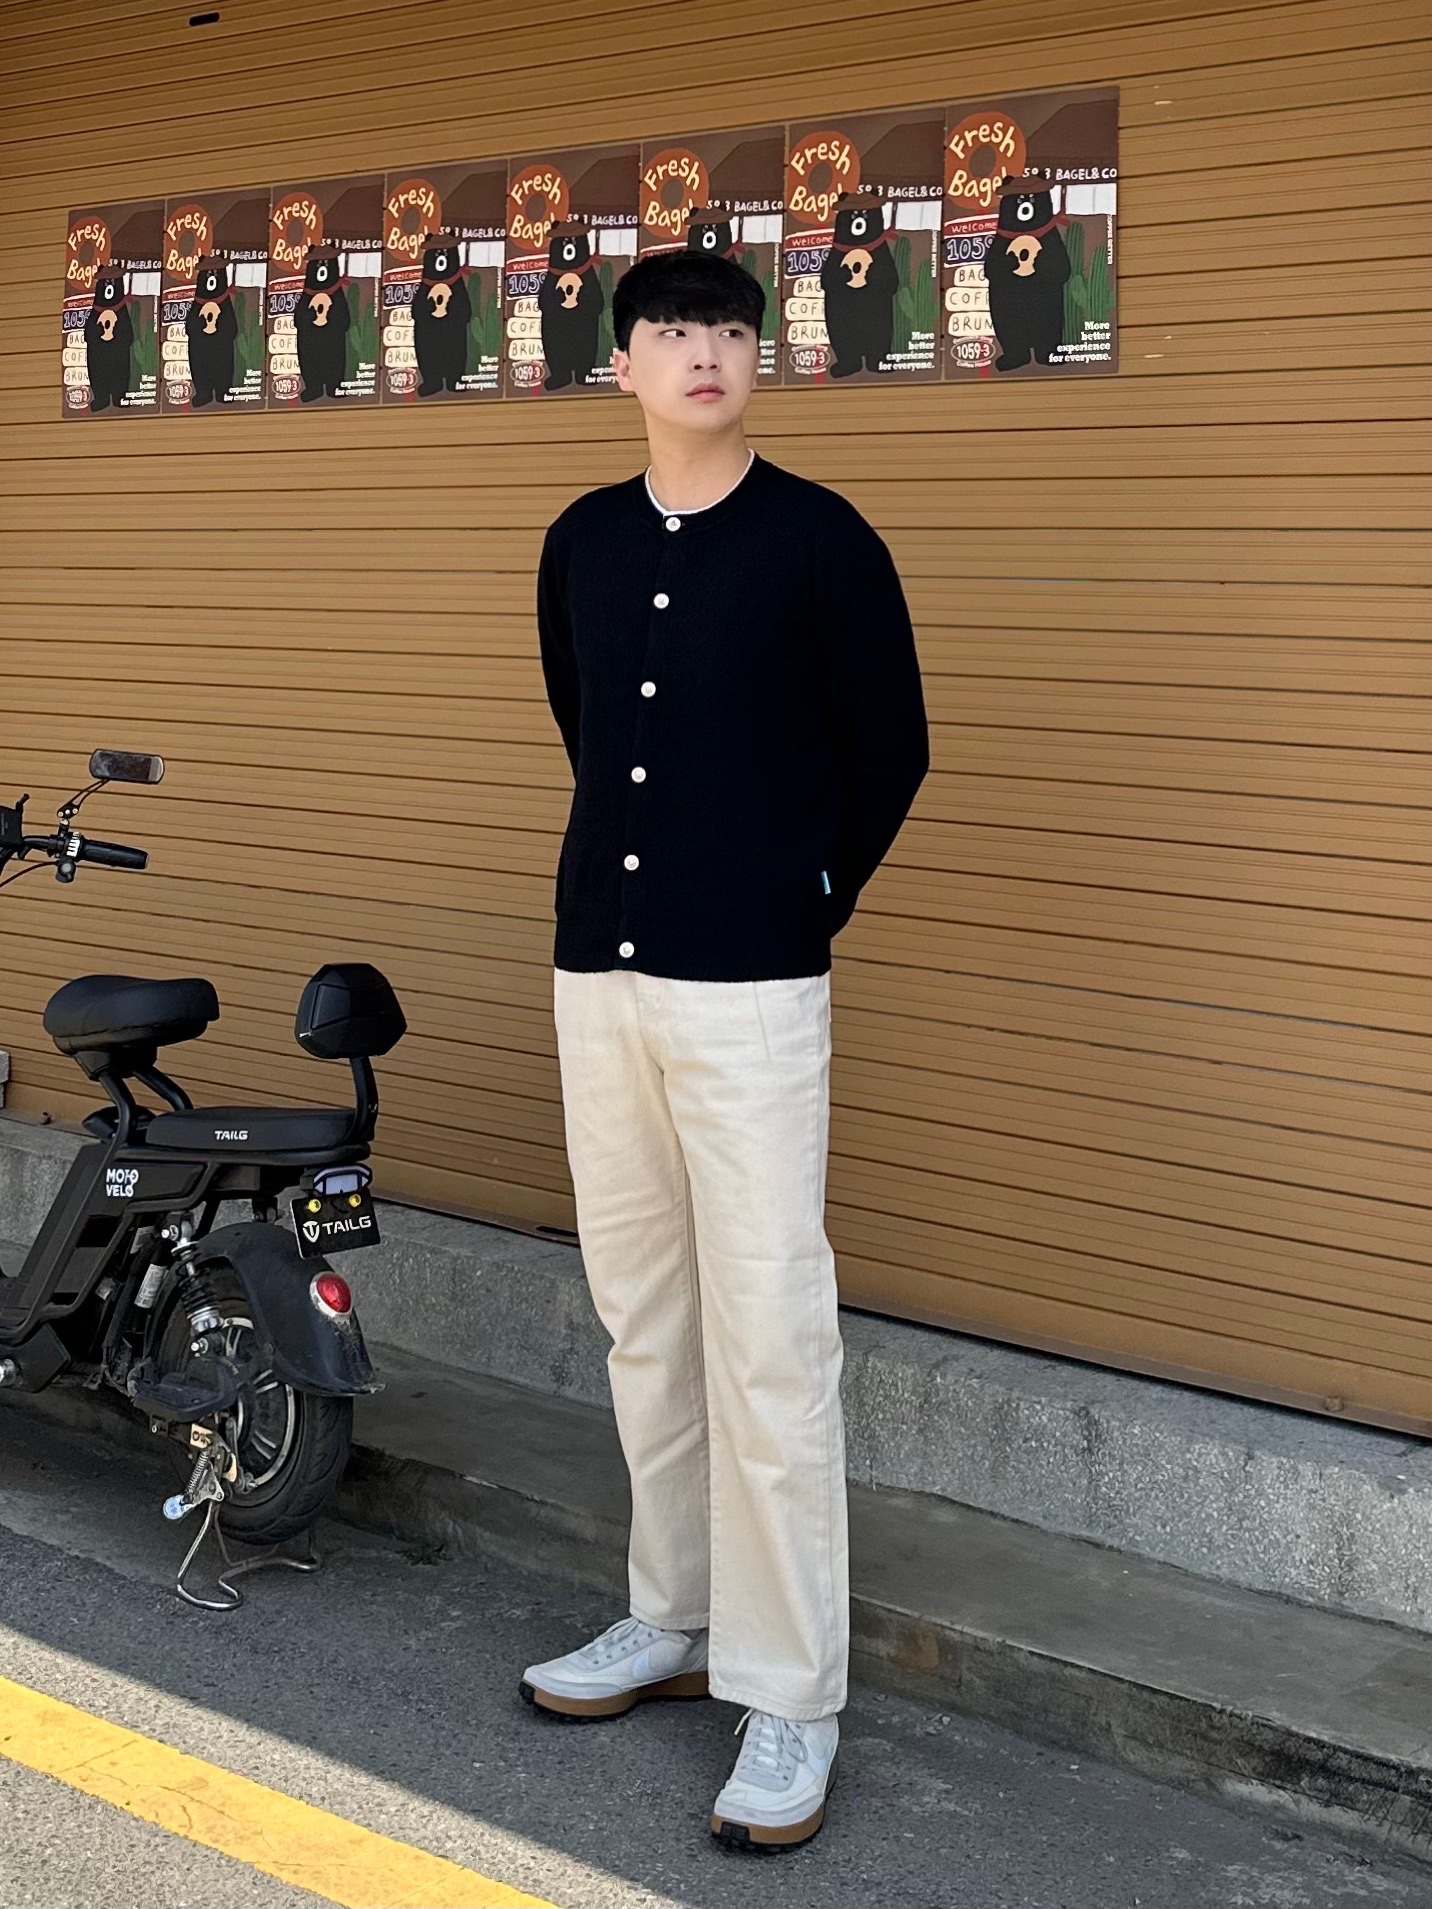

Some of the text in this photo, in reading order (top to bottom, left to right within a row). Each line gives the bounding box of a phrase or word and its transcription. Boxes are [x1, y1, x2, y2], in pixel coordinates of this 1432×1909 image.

[950, 122, 1016, 159] Fresh
[791, 140, 851, 176] Fresh
[643, 157, 700, 192] Fresh
[511, 173, 562, 206] Fresh
[388, 187, 435, 219] Fresh
[273, 200, 317, 231] Fresh
[167, 212, 207, 242] Fresh
[952, 220, 996, 233] welcome
[68, 224, 105, 252] Fresh
[792, 234, 833, 246] welcome
[1084, 321, 1110, 331] More
[911, 331, 934, 341] More
[1081, 331, 1111, 341] better
[907, 341, 934, 350] better
[956, 342, 990, 359] 1059-3
[1056, 342, 1111, 353] experience
[795, 350, 825, 366] 1059-3
[878, 361, 891, 371] for
[1049, 352, 1112, 364] for everyone.
[214, 1130, 249, 1140] TAILG
[105, 1168, 139, 1184] MOTO
[105, 1184, 134, 1198] VELO
[321, 1215, 372, 1236] TAILG
